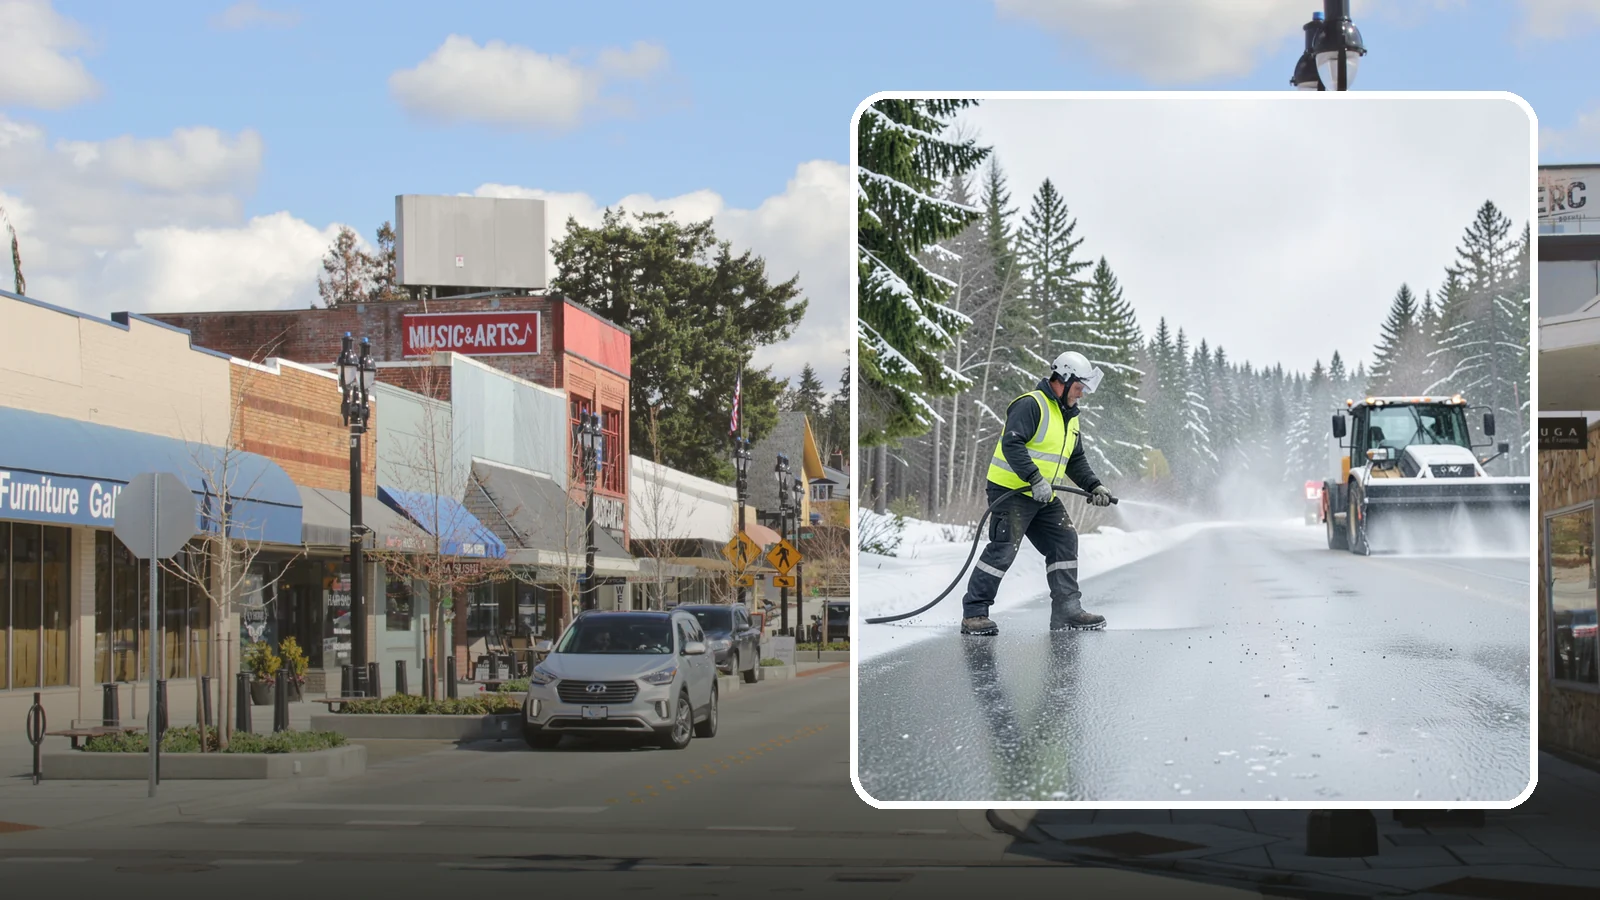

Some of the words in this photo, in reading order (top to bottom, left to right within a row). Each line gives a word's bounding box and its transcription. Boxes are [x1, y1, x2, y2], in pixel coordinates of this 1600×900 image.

[408, 323, 520, 349] MUSIC&ARTS
[0, 471, 79, 515] Furniture
[453, 563, 479, 574] SUSHI
